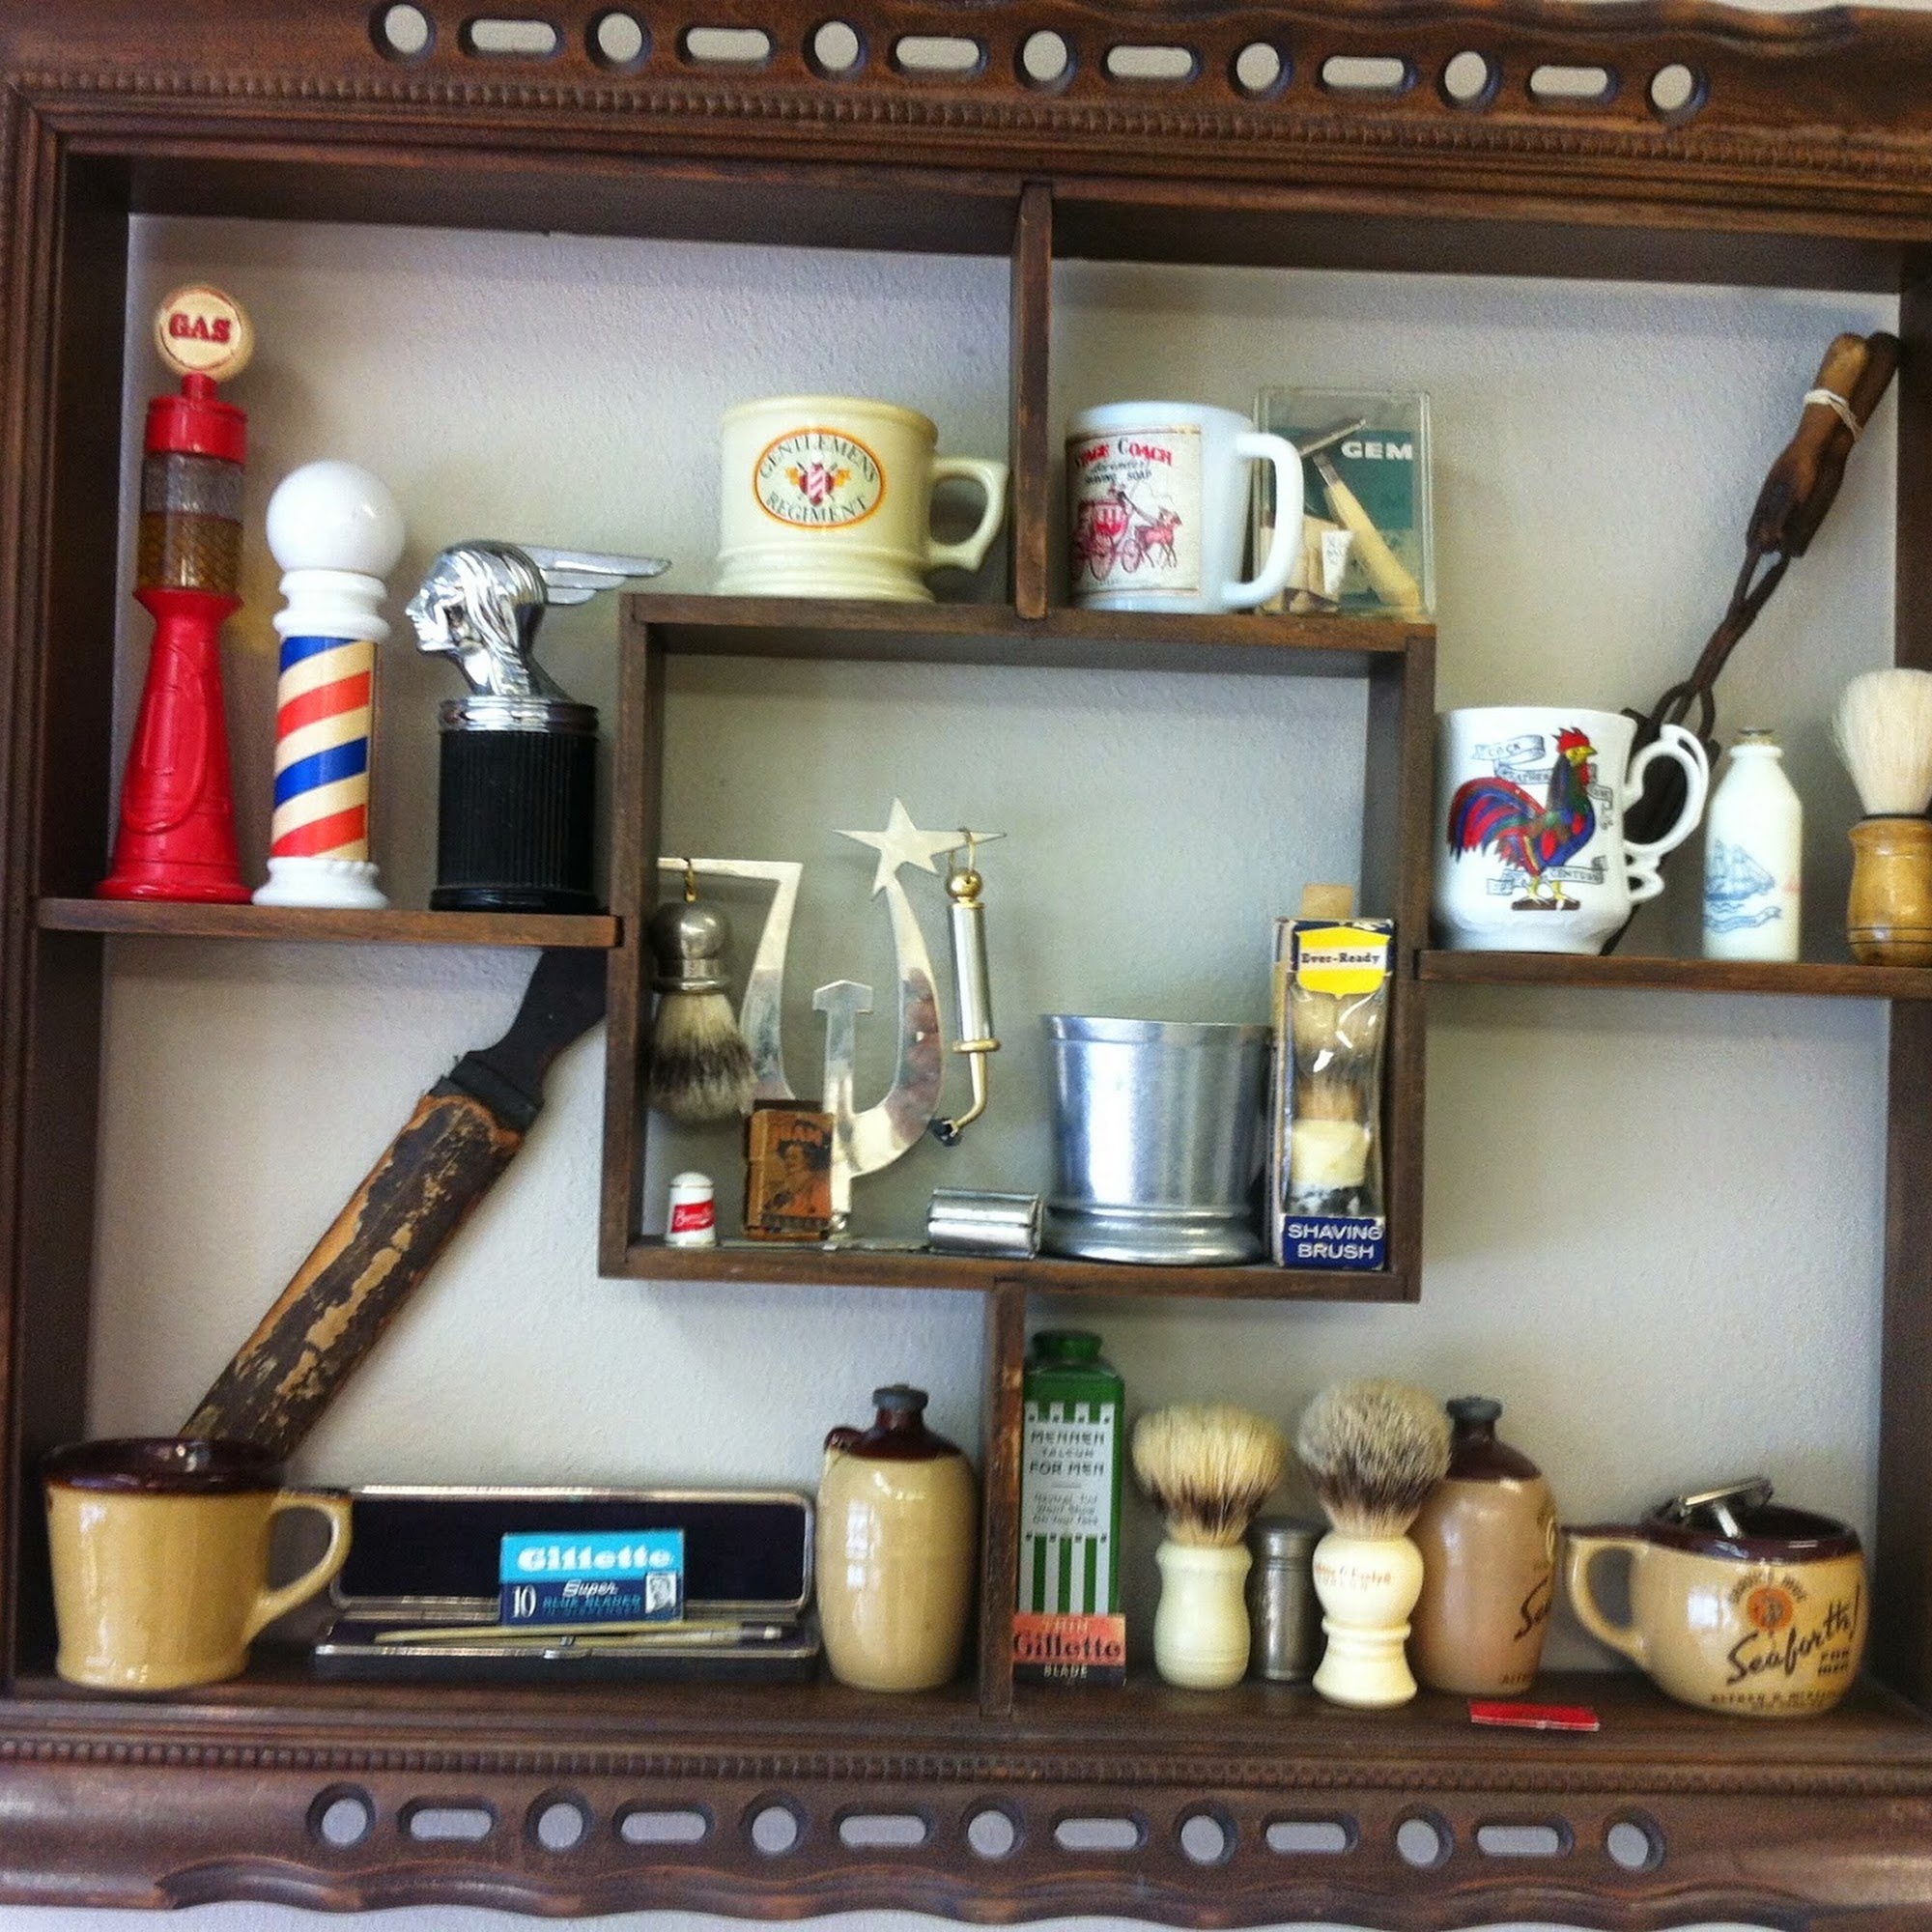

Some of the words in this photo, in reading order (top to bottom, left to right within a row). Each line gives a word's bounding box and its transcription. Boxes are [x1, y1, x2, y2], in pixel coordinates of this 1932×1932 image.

[169, 313, 231, 343] GAS
[1118, 437, 1173, 466] COACH
[1341, 440, 1413, 460] GEM
[766, 491, 867, 523] REGIMENT
[1301, 952, 1380, 965] Ever-Ready
[1288, 1223, 1382, 1240] SHAVING
[1297, 1242, 1375, 1260] BRUSH
[1031, 1430, 1105, 1445] MENNEN
[1029, 1461, 1062, 1476] FOR
[1068, 1463, 1105, 1477] MEN
[518, 1545, 673, 1572] Gillette
[562, 1579, 619, 1599] Super
[512, 1584, 537, 1618] 10
[1013, 1630, 1121, 1657] Gillette
[1044, 1663, 1089, 1679] BLADE
